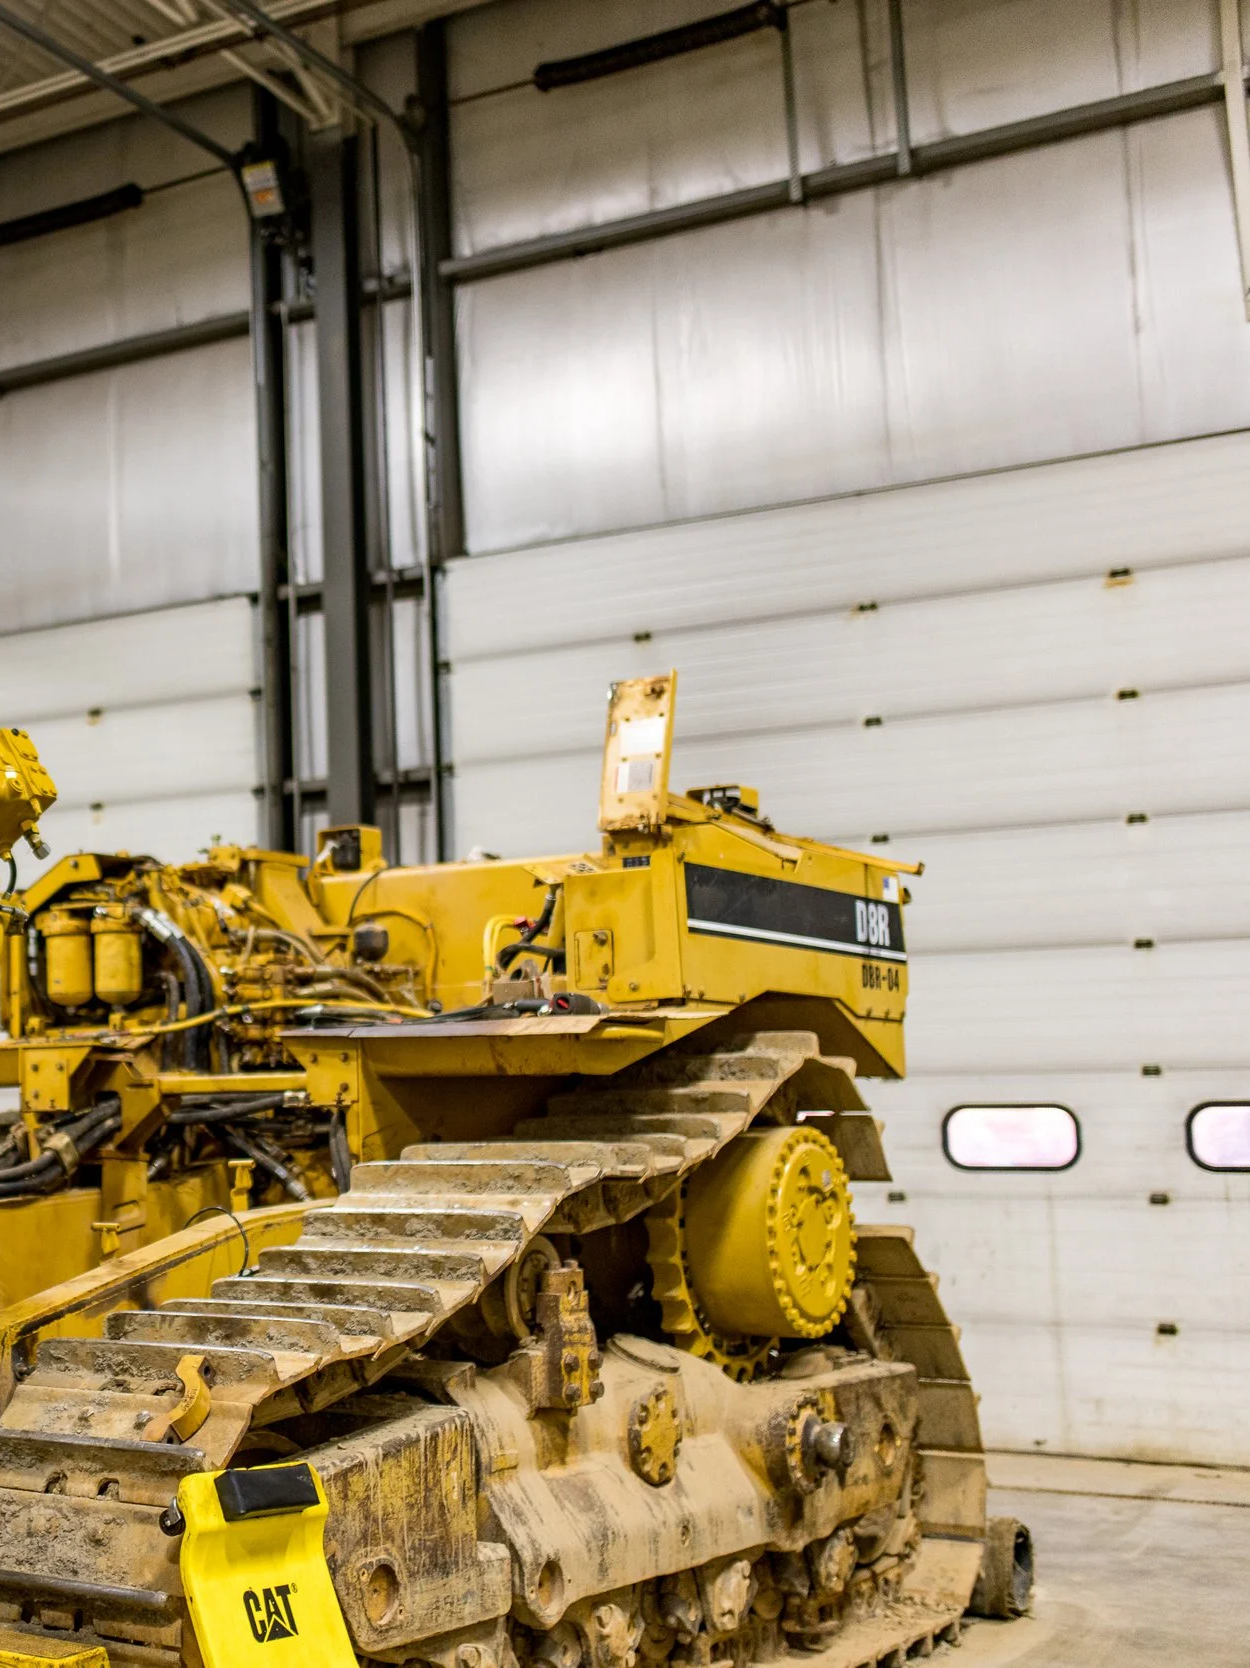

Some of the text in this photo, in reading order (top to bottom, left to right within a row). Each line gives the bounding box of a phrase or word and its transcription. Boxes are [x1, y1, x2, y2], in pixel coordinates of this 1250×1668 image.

[855, 900, 891, 947] D8R
[861, 963, 900, 993] D8R-04
[242, 1583, 299, 1644] CAT
